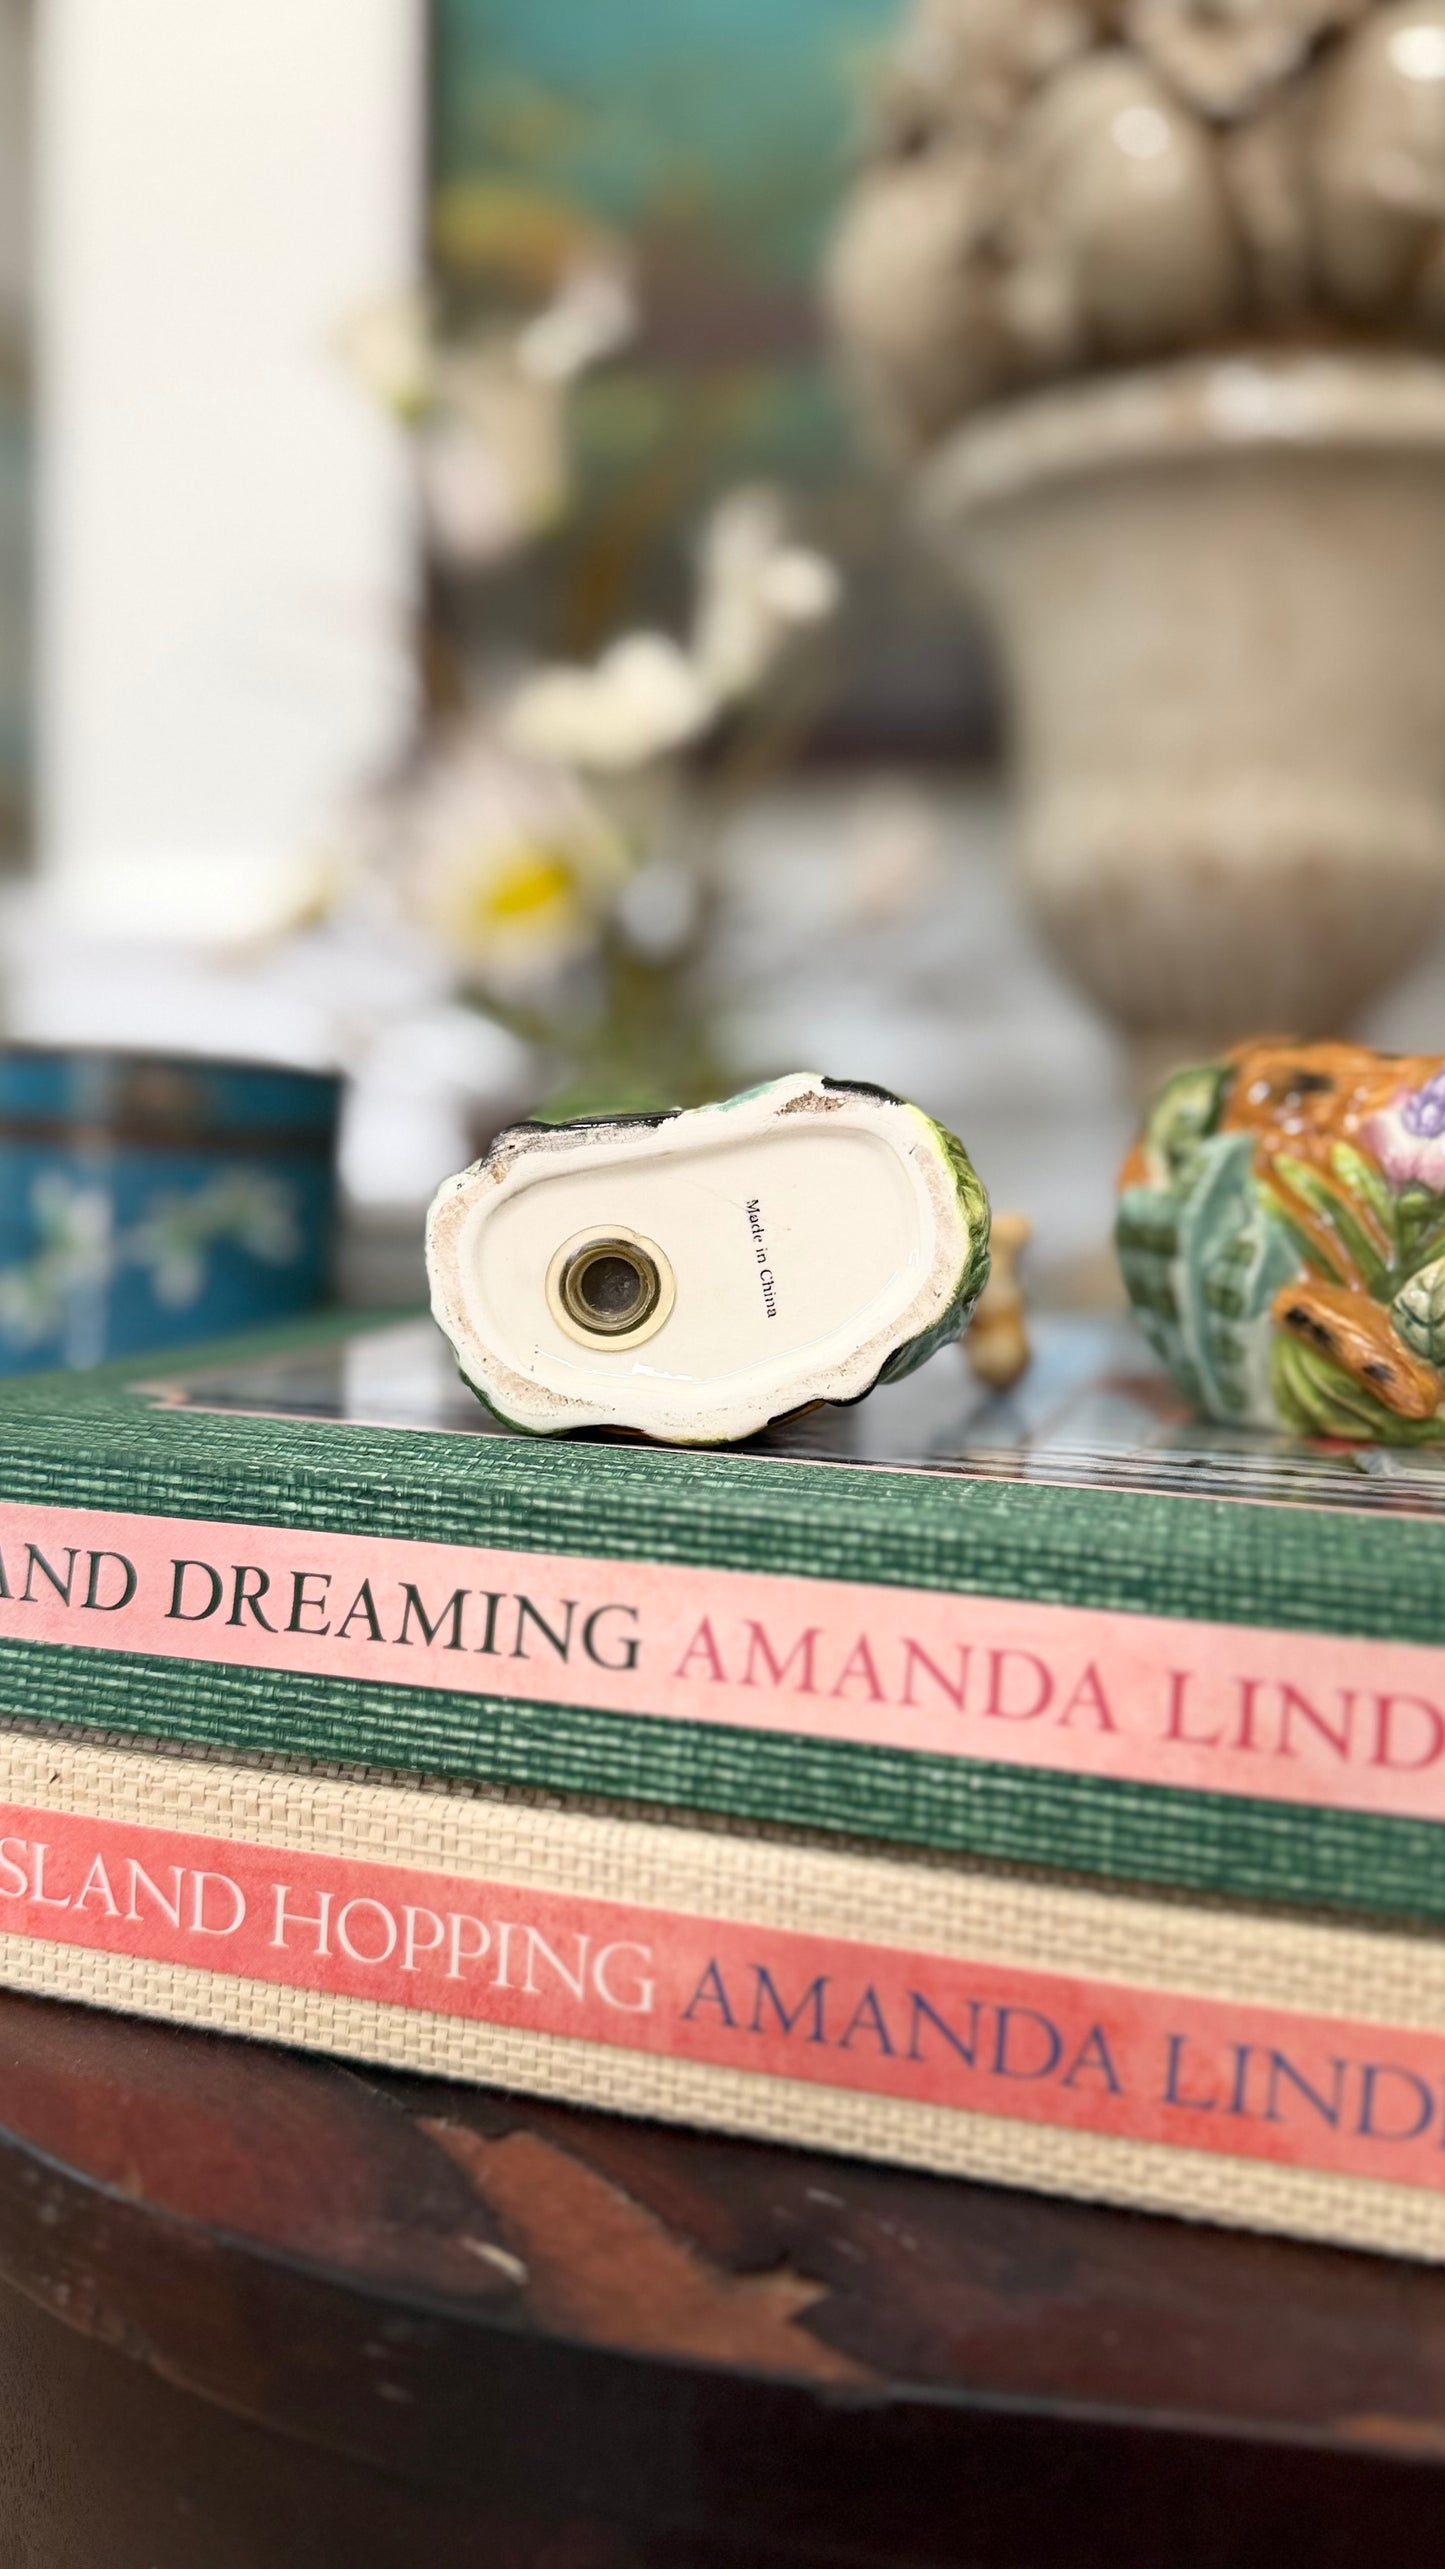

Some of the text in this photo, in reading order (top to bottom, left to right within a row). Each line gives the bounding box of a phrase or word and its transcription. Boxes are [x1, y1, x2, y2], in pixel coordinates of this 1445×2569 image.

[746, 1199, 777, 1318] Made in China
[164, 1559, 643, 1671] DREAMING
[673, 1614, 1119, 1734] AMANDA
[1162, 1669, 1445, 1772] LIND
[0, 1836, 1445, 2150] SLAND HOPPING AMANDA LIND
